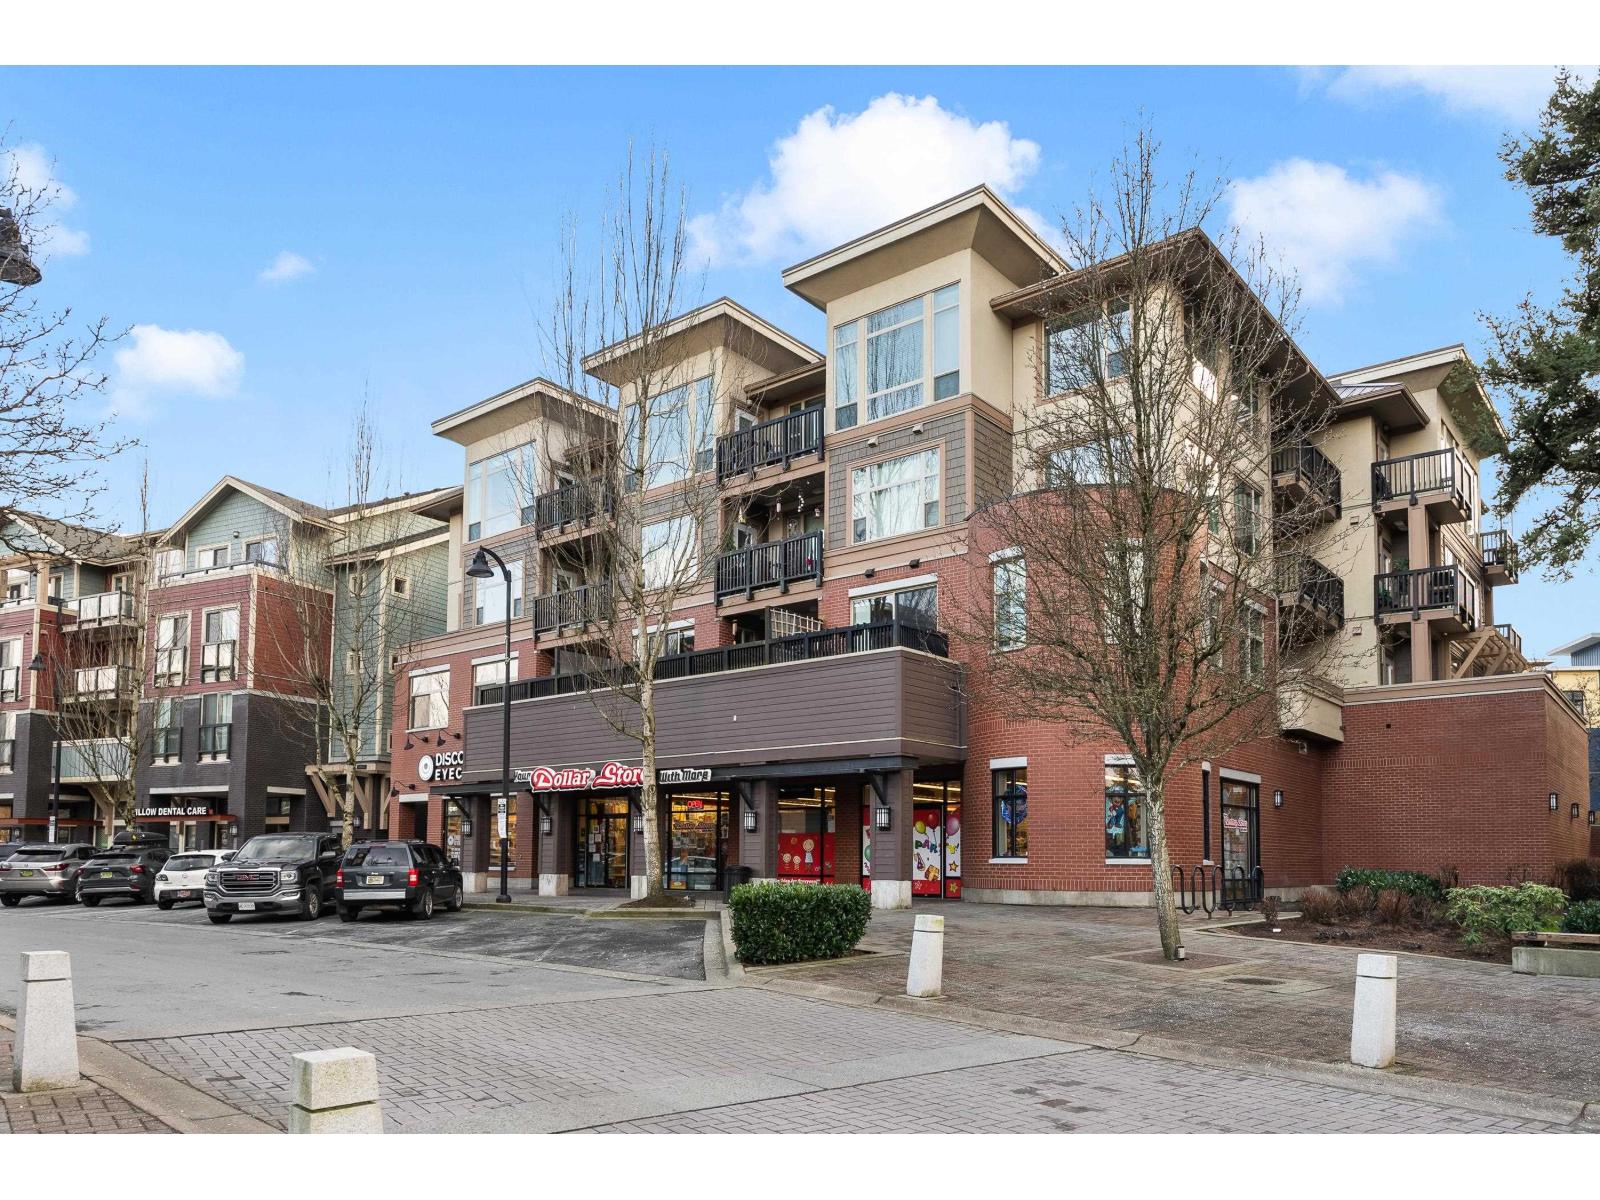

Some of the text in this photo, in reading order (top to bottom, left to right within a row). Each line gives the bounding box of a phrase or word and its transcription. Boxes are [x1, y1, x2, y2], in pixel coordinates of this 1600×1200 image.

[531, 767, 591, 791] Dollar
[592, 762, 644, 788] Stor
[682, 769, 711, 782] More
[687, 799, 704, 809] OPEN
[135, 806, 207, 816] ILLOW DENTAL CARE
